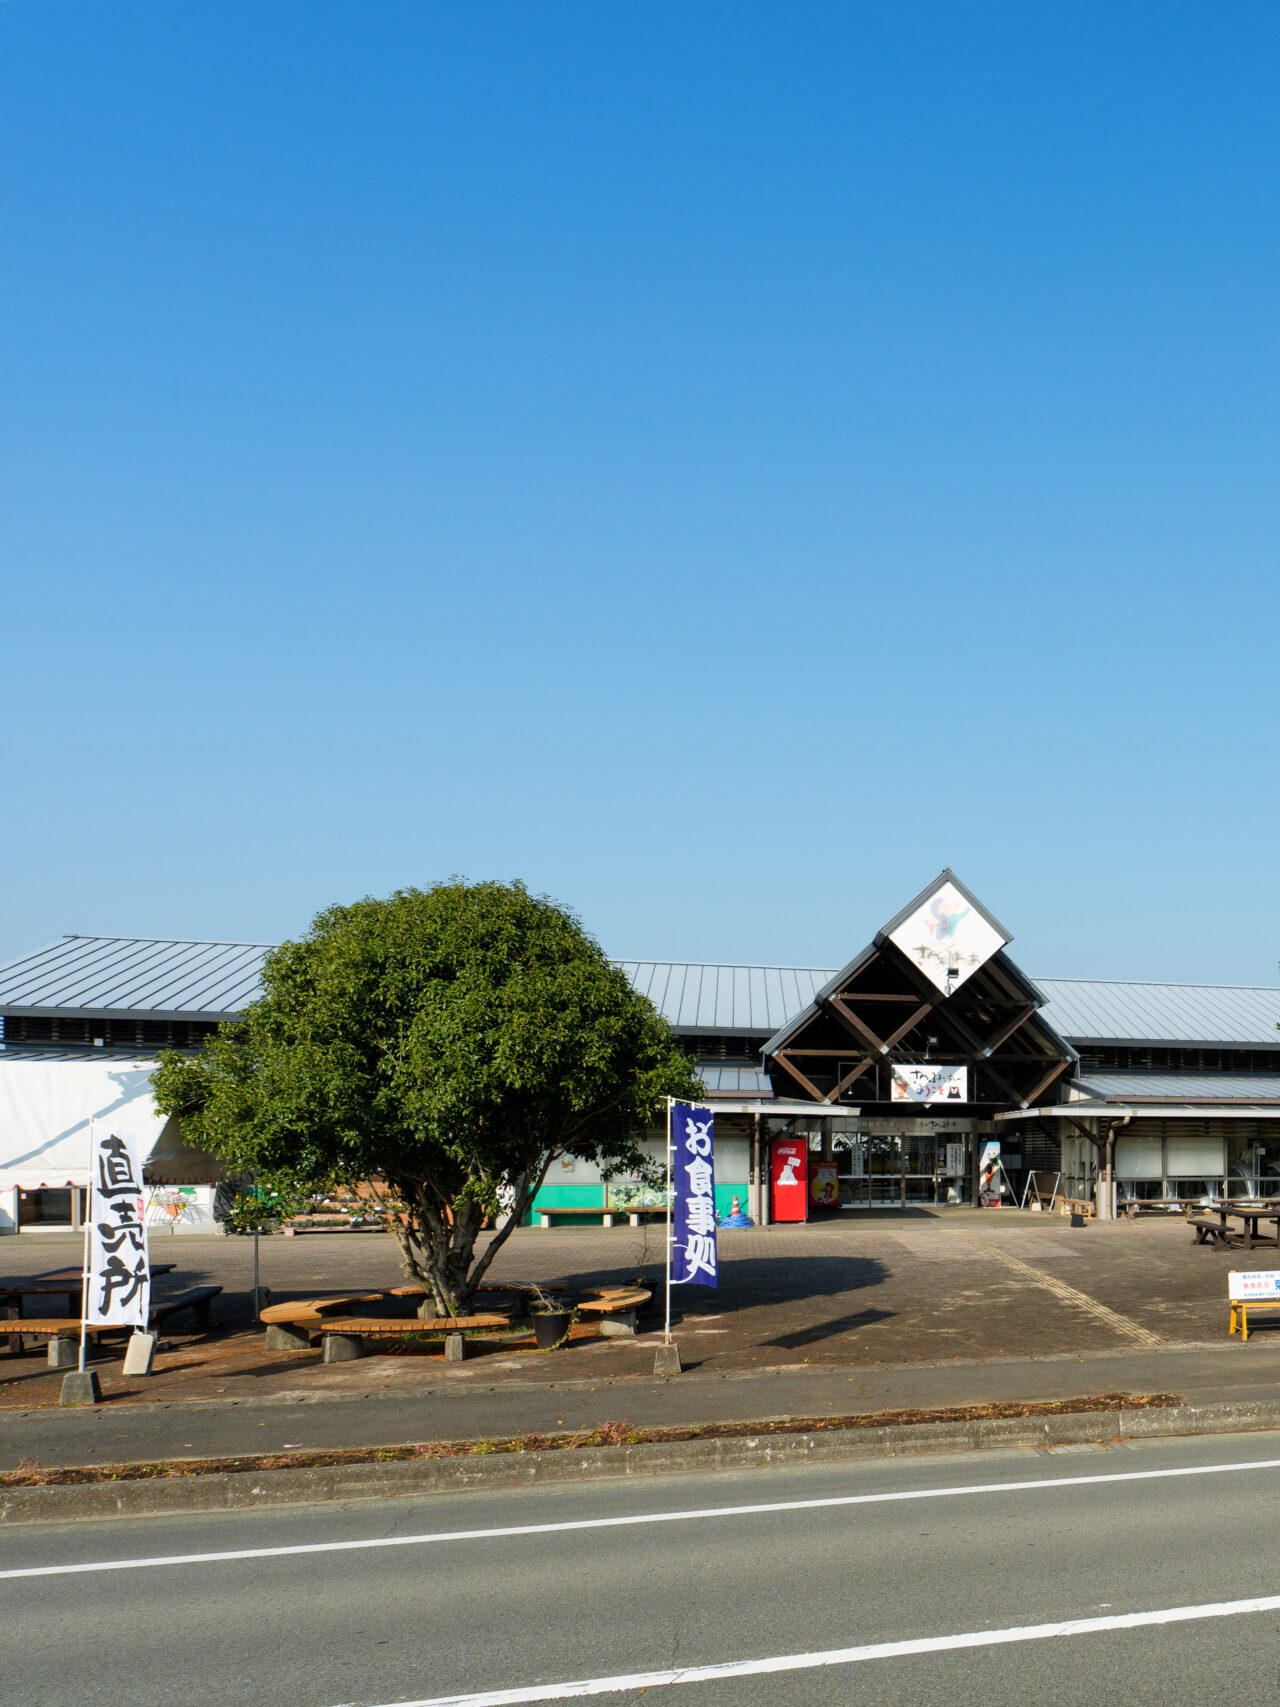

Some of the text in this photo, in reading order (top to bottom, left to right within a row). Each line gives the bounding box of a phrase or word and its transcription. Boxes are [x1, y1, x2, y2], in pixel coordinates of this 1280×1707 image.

[915, 1084, 944, 1098] ようこそ
[97, 1133, 149, 1320] 直売所
[682, 1117, 717, 1277] お食事処
